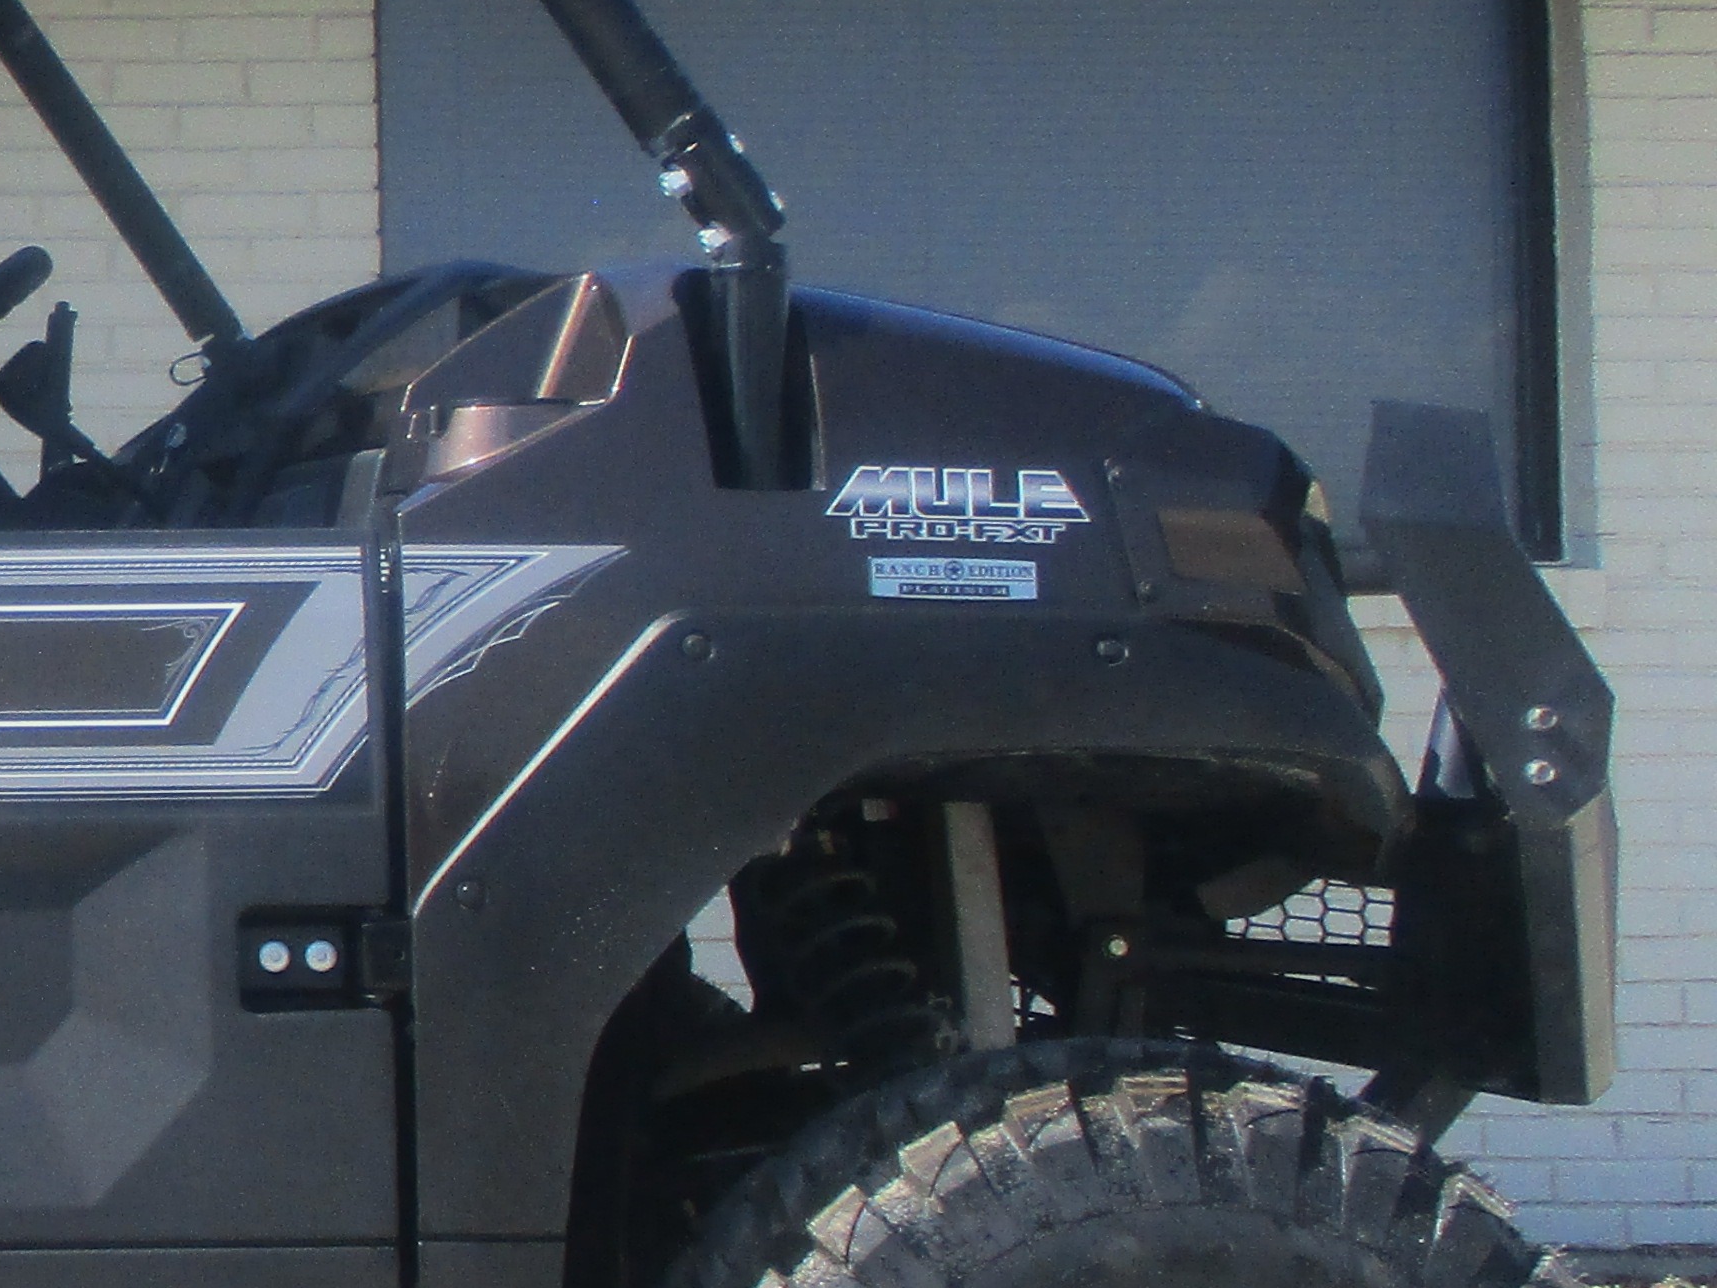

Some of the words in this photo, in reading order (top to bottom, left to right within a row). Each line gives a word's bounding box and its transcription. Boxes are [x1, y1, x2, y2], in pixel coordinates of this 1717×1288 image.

[825, 465, 1092, 523] MULE
[874, 563, 941, 576] RANCH
[967, 564, 1034, 577] EDITION
